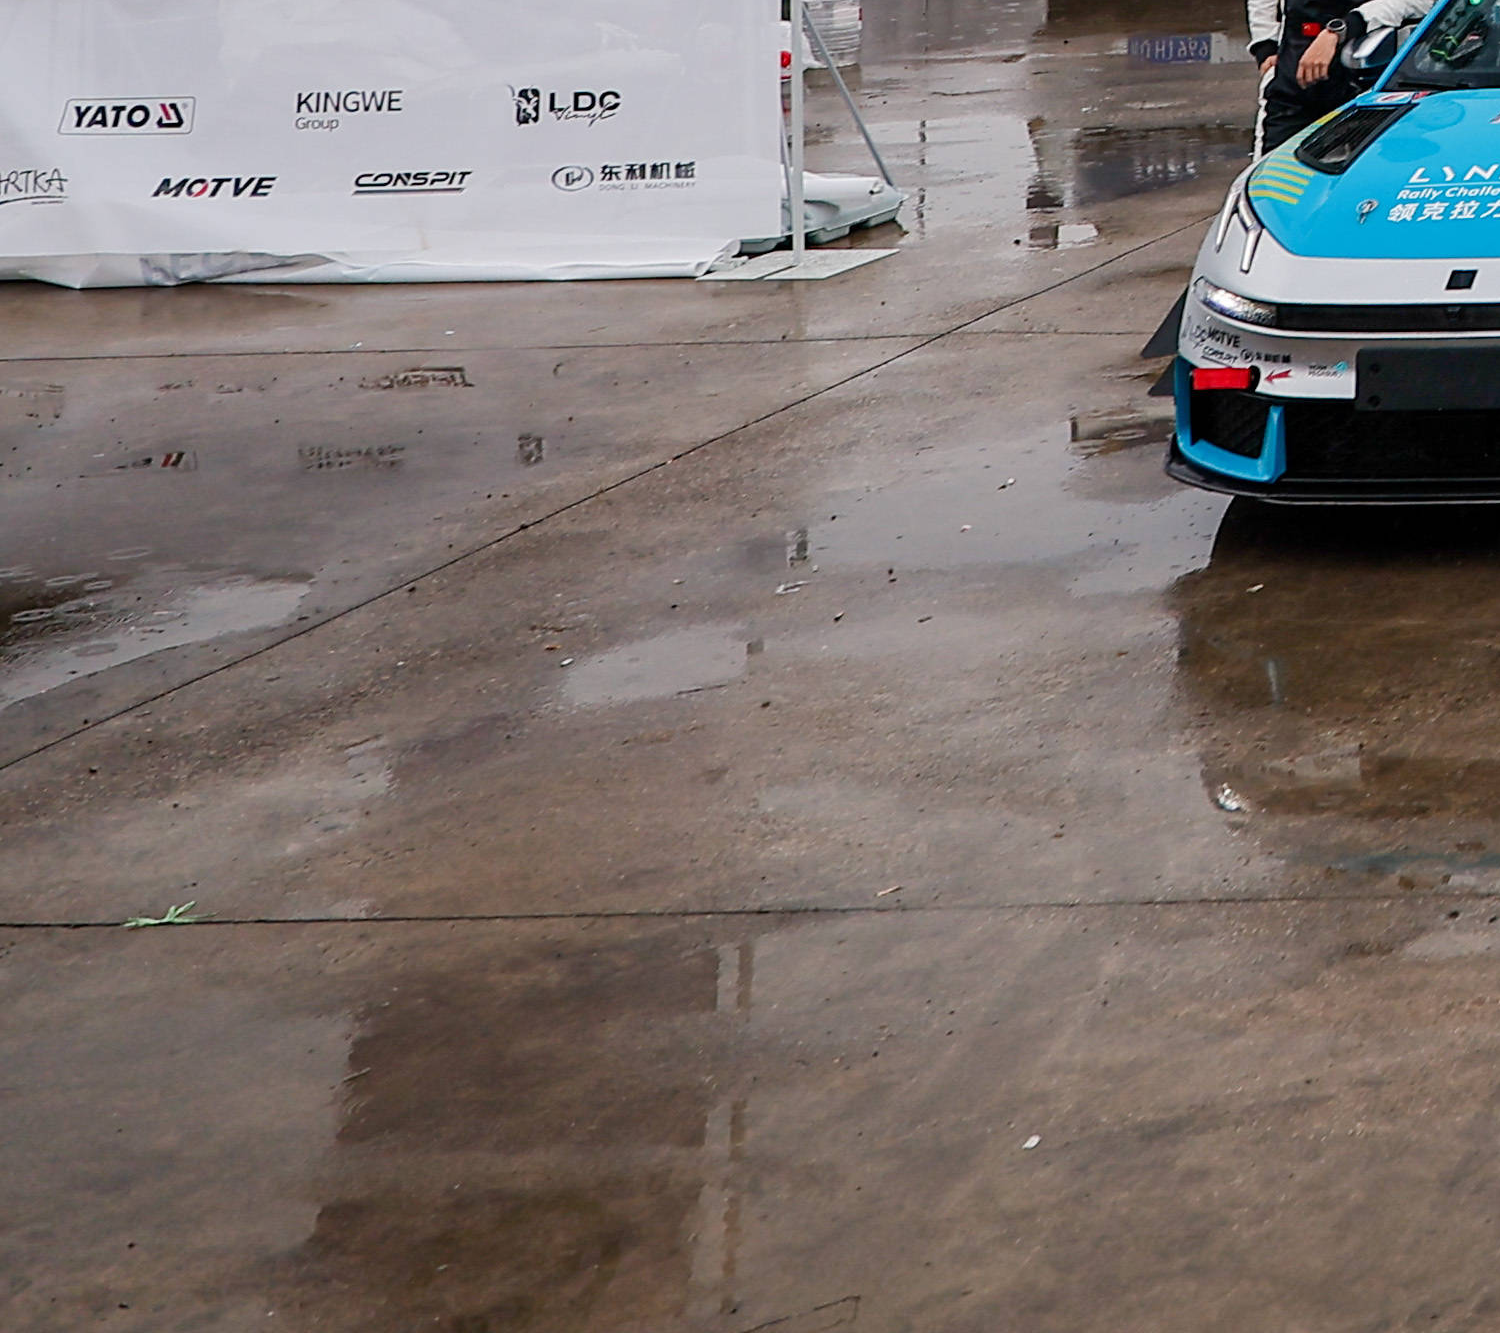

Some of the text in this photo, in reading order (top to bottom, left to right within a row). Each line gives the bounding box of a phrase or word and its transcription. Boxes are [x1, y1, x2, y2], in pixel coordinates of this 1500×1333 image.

[296, 90, 403, 113] KINGWE
[550, 91, 621, 112] LDC
[74, 105, 150, 127] YATO
[295, 118, 339, 131] Group
[354, 170, 472, 188] CONSPIT
[600, 160, 696, 180] 东利机械
[152, 176, 278, 197] MOTVE
[1397, 187, 1442, 200] Rally
